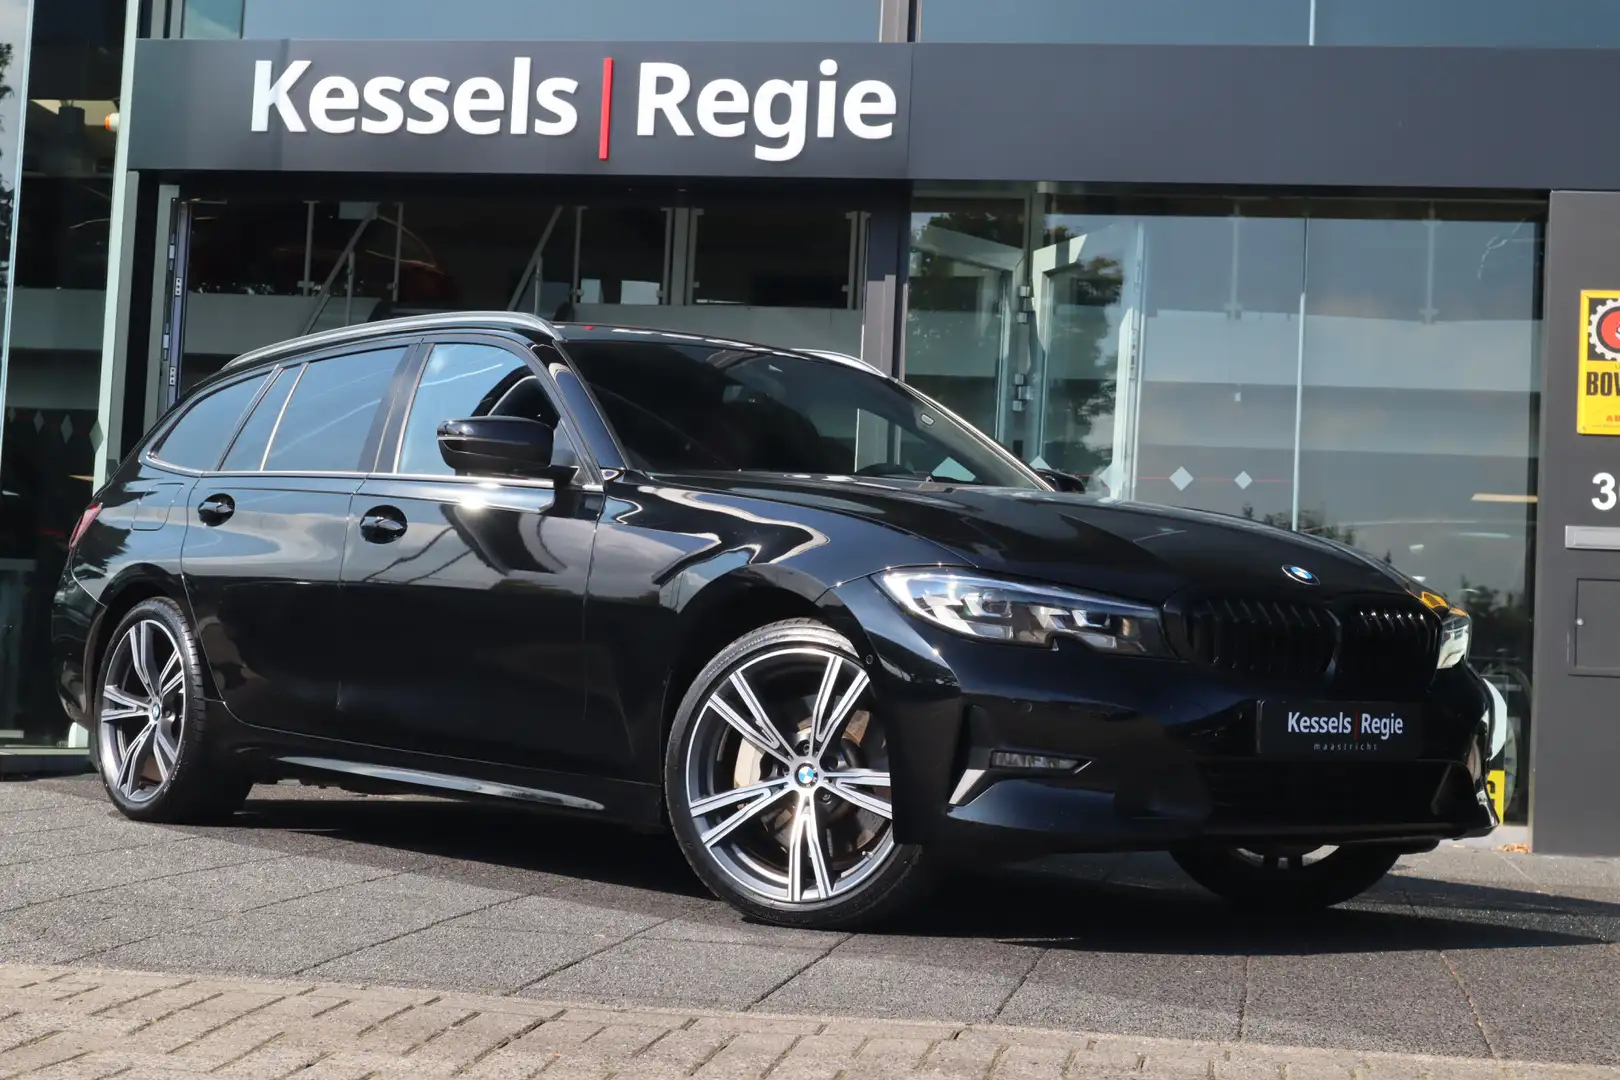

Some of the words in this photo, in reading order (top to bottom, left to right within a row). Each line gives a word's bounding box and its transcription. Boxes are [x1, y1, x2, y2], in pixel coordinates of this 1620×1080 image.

[250, 56, 579, 137] Kessels
[636, 58, 897, 163] Regie
[1591, 472, 1620, 511] 3
[1287, 711, 1352, 734] Kessels
[1361, 713, 1404, 740] Regie
[1313, 742, 1378, 751] maastricht
